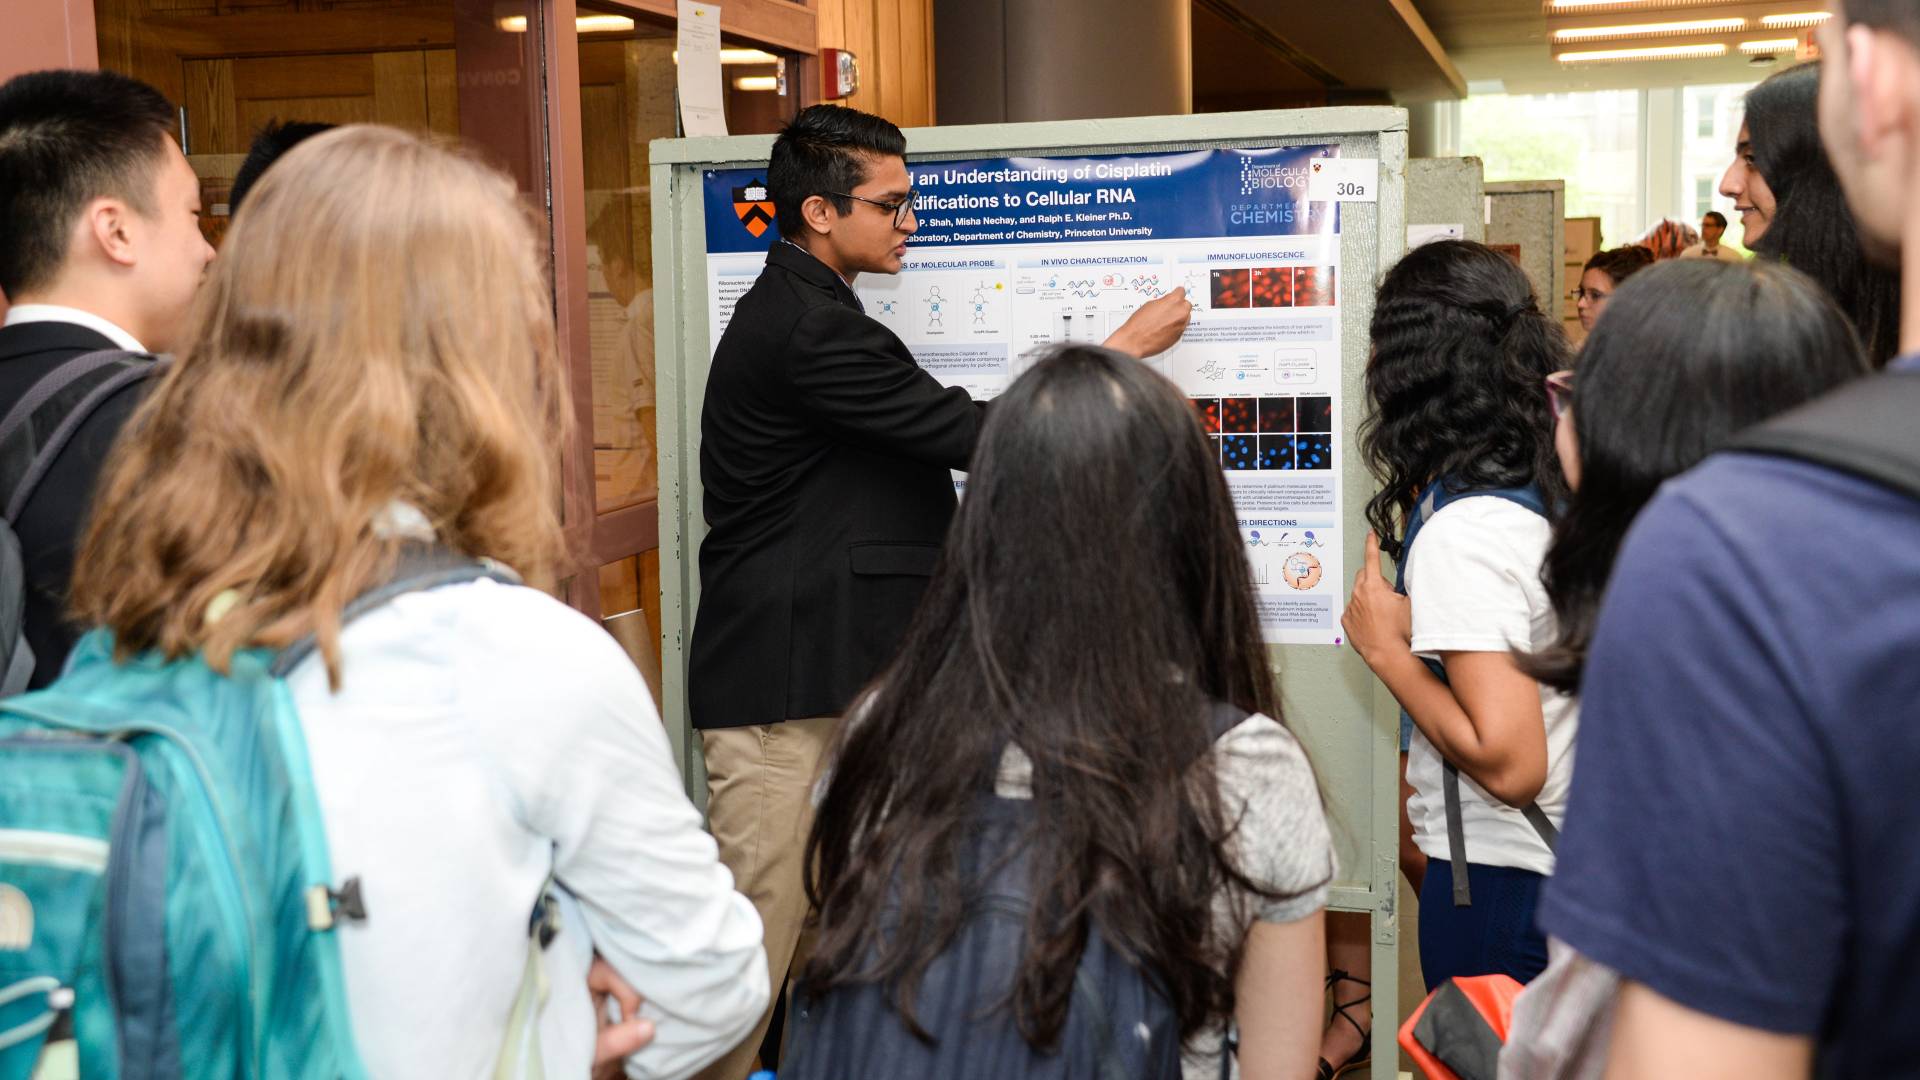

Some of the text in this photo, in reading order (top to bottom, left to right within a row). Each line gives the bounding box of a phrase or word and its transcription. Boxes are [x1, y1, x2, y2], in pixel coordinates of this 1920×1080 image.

[919, 173, 939, 185] an
[944, 166, 1068, 184] Understanding
[1073, 165, 1090, 179] of
[1095, 162, 1172, 180] Cisplatin
[1252, 168, 1309, 177] MOLECULA
[1252, 177, 1309, 188] BIOLOG
[1336, 183, 1364, 195] 30a
[914, 188, 1136, 210] difications to Cellular RNA
[1231, 202, 1299, 211] DEPARTMEN
[919, 212, 1132, 228] P. Shah, Misha Nechay, and Ralph E. Kleiner Ph.D.
[953, 231, 1004, 242] Department
[1005, 231, 1014, 240] of
[1016, 230, 1062, 239] Chemistry,
[1064, 228, 1106, 237] Princeton
[1108, 227, 1152, 236] University
[1070, 256, 1148, 265] CHARACTERIZATION
[1207, 251, 1305, 260] IMMUNOFLUORESCENCE
[921, 261, 967, 269] MOLECULAR
